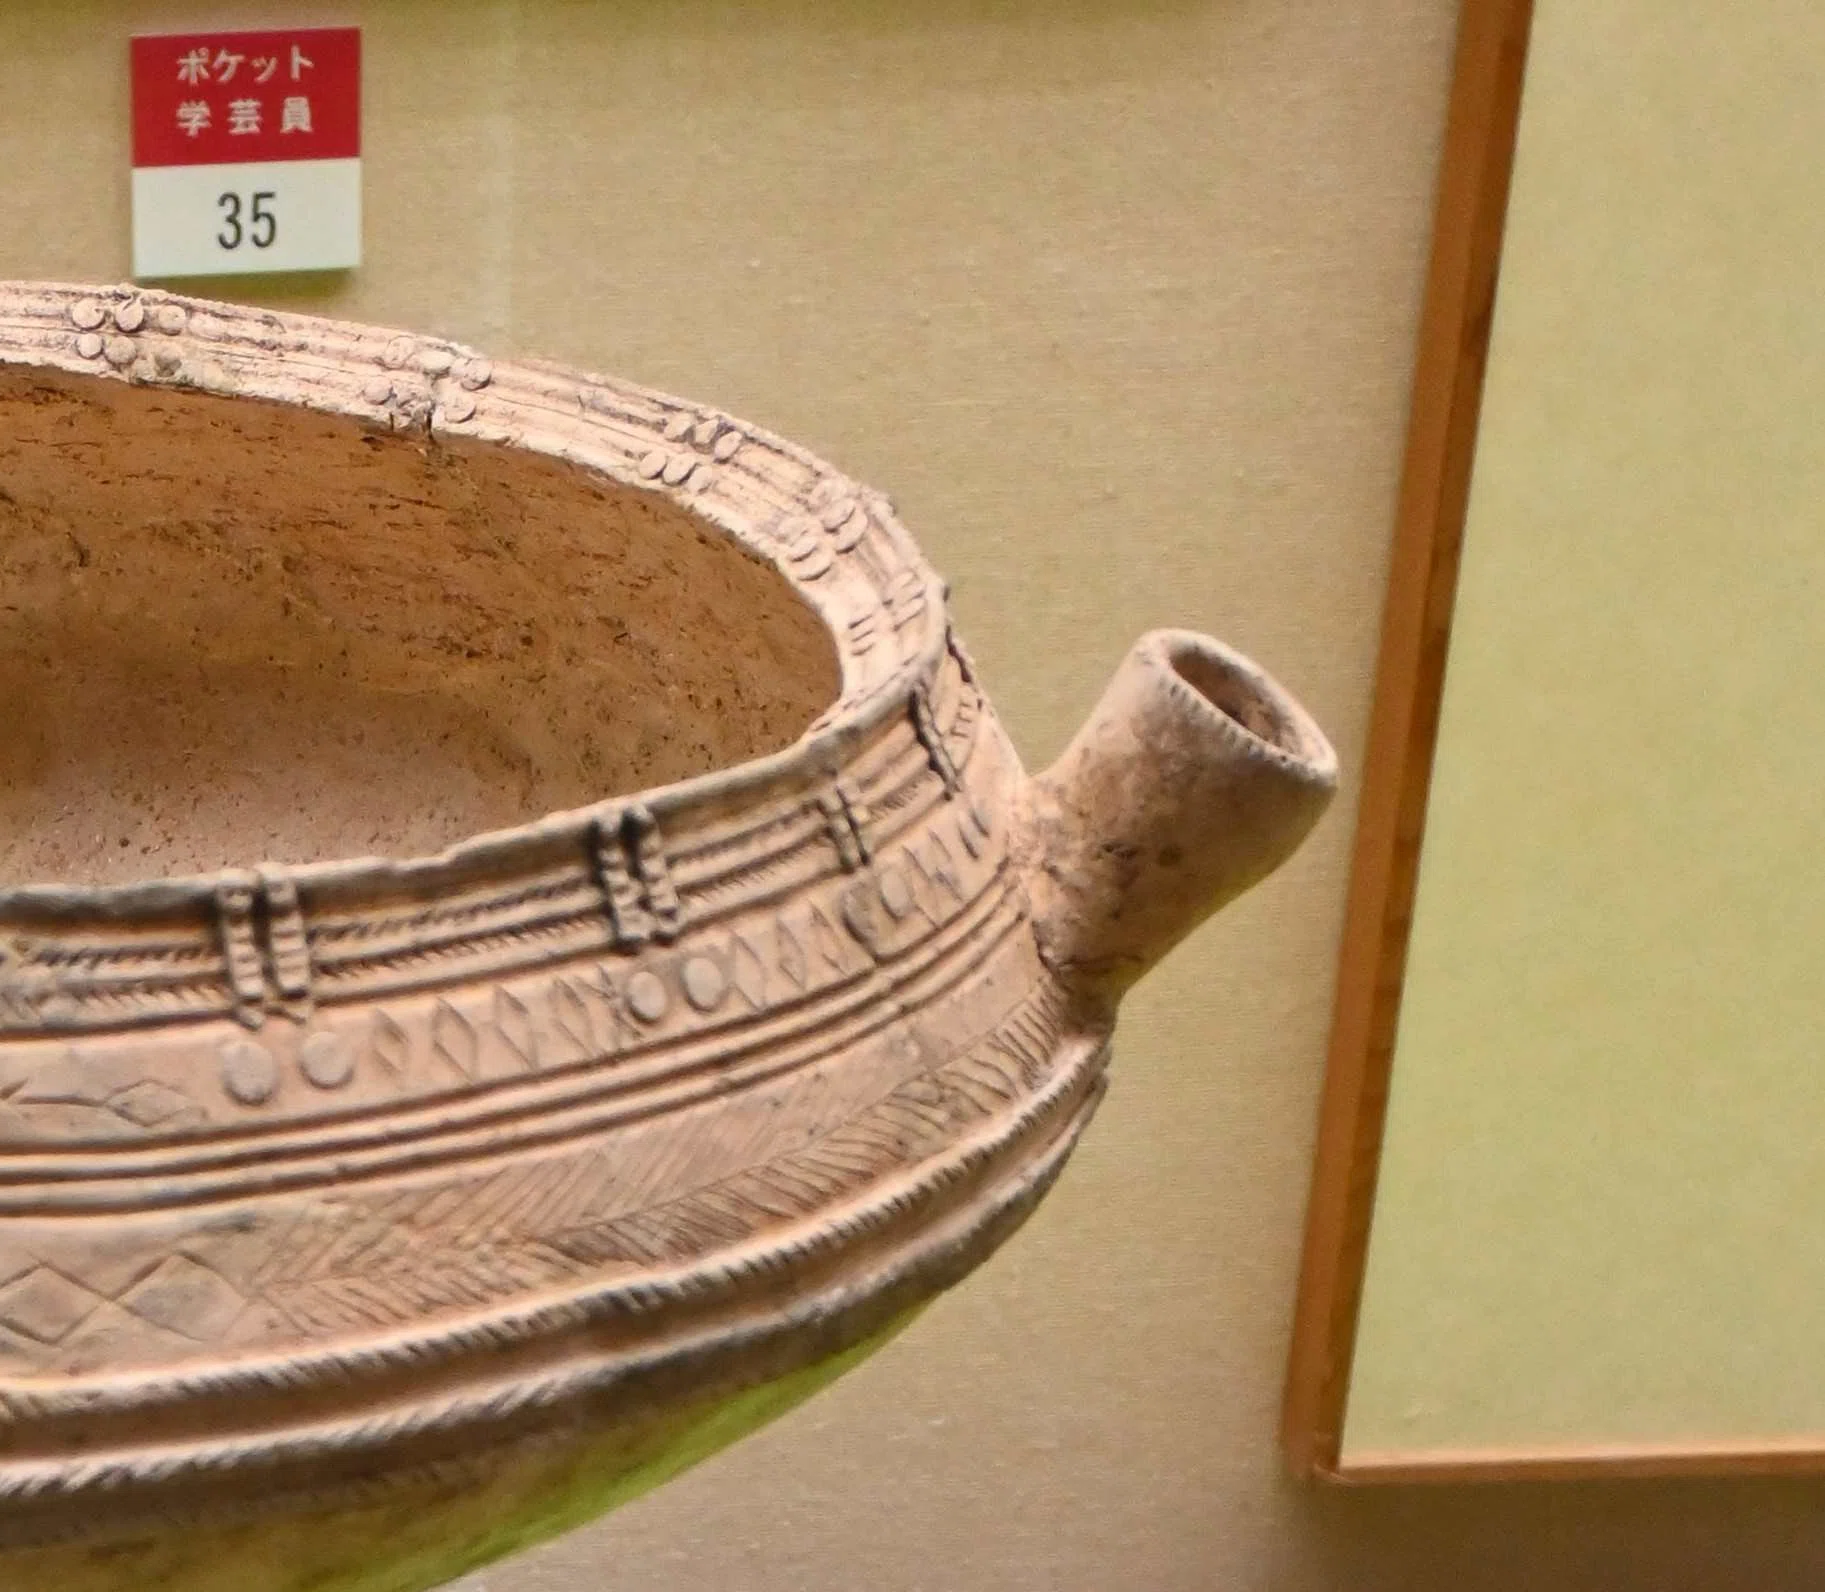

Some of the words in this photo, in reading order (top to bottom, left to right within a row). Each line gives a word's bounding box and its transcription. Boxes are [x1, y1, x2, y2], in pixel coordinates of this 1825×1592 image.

[177, 45, 314, 86] ポケット
[177, 96, 313, 138] 学芸員
[217, 191, 276, 250] 35
